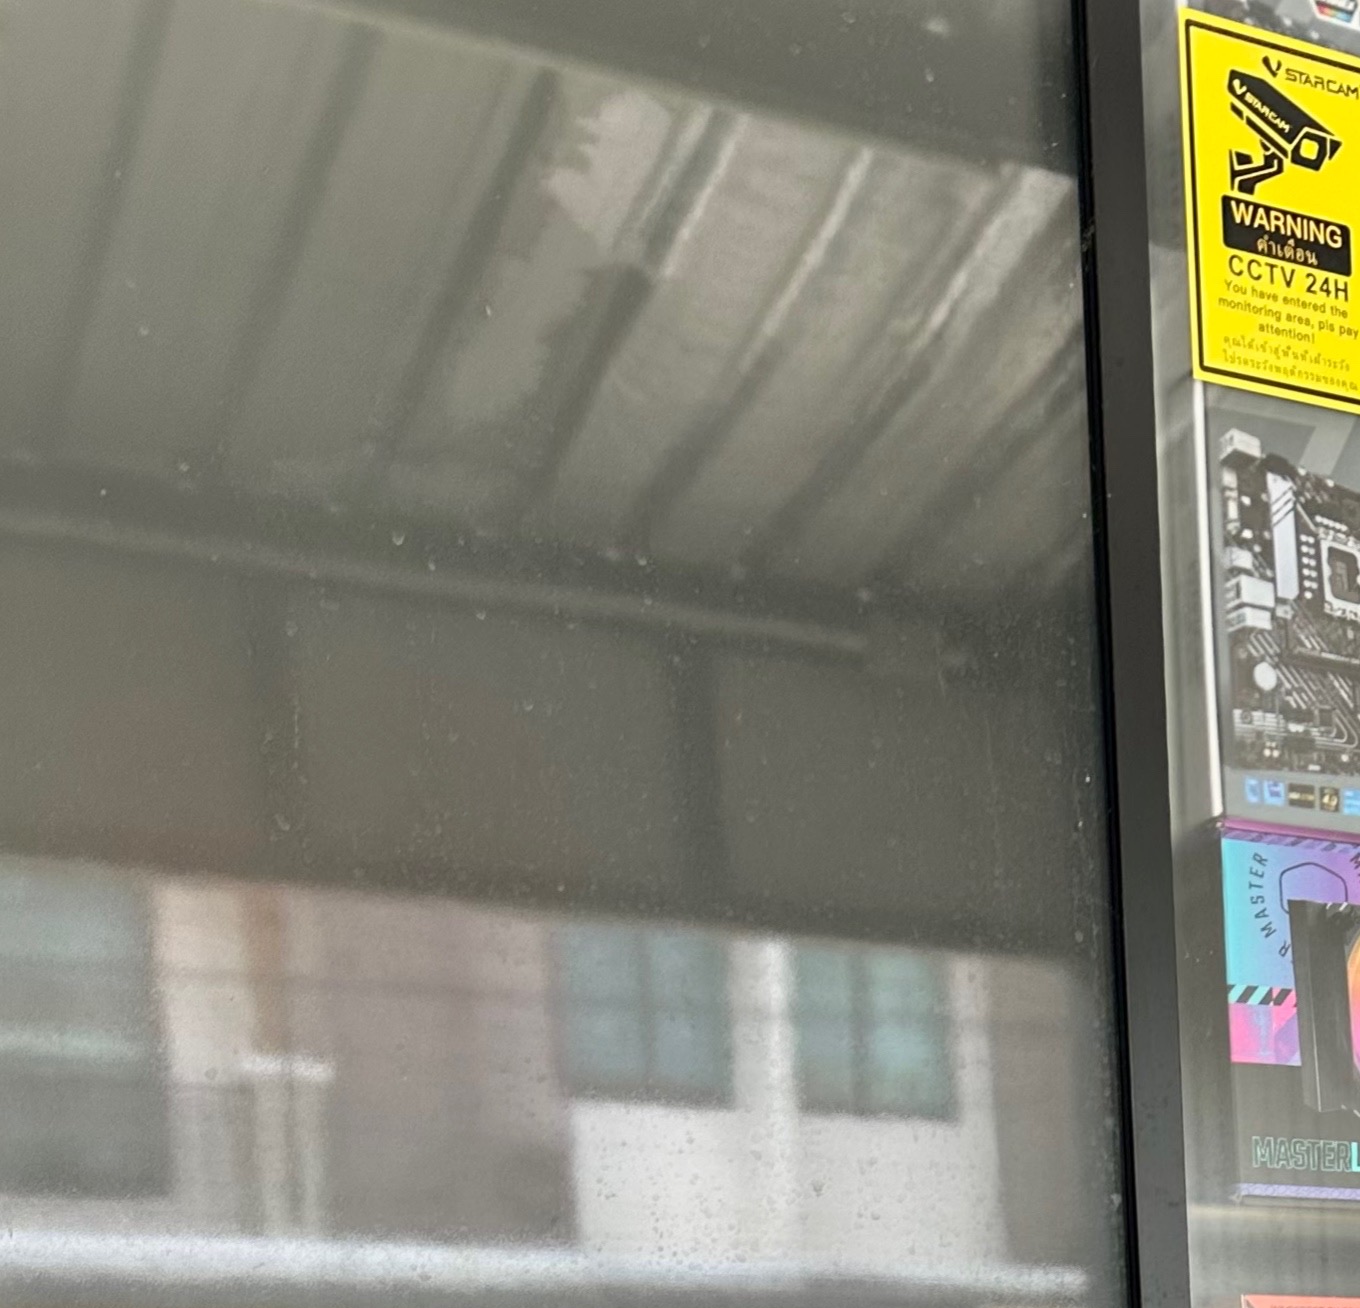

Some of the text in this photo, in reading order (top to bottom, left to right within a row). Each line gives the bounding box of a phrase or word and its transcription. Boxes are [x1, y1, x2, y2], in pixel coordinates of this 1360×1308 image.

[1231, 201, 1344, 249] WARNING
[1256, 234, 1317, 266] คำเตือน
[1228, 254, 1349, 301] CCTV 24H
[1218, 297, 1282, 325] monitoring
[1285, 310, 1314, 330] area,
[1339, 322, 1359, 340] pay
[1224, 279, 1348, 319] You have entered the
[1258, 322, 1315, 344] attention!
